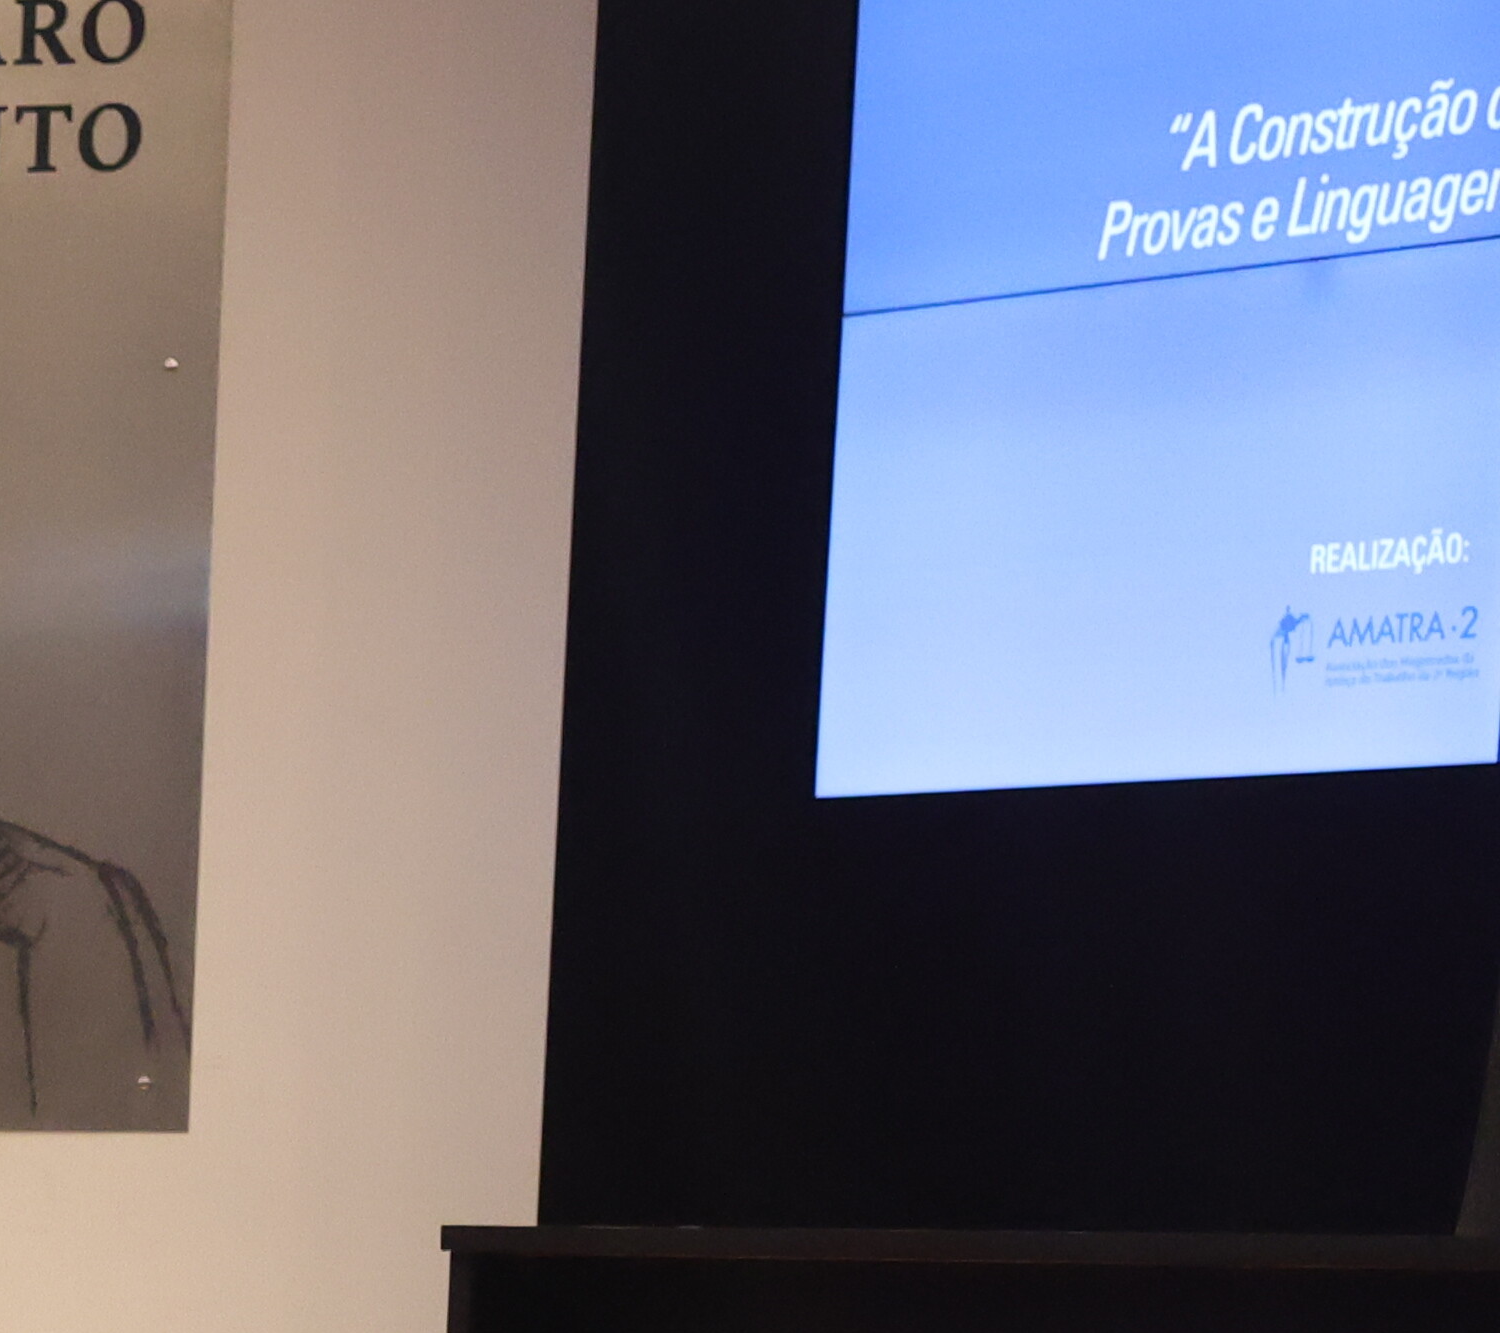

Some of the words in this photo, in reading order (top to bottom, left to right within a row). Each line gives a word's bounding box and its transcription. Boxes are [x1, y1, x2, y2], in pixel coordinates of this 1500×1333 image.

[1229, 77, 1479, 165] Construção
[1098, 200, 1245, 260] Provas
[1251, 196, 1280, 242] e
[1286, 168, 1500, 244] Linguage
[1309, 527, 1471, 575] REALIZAÇÃO:
